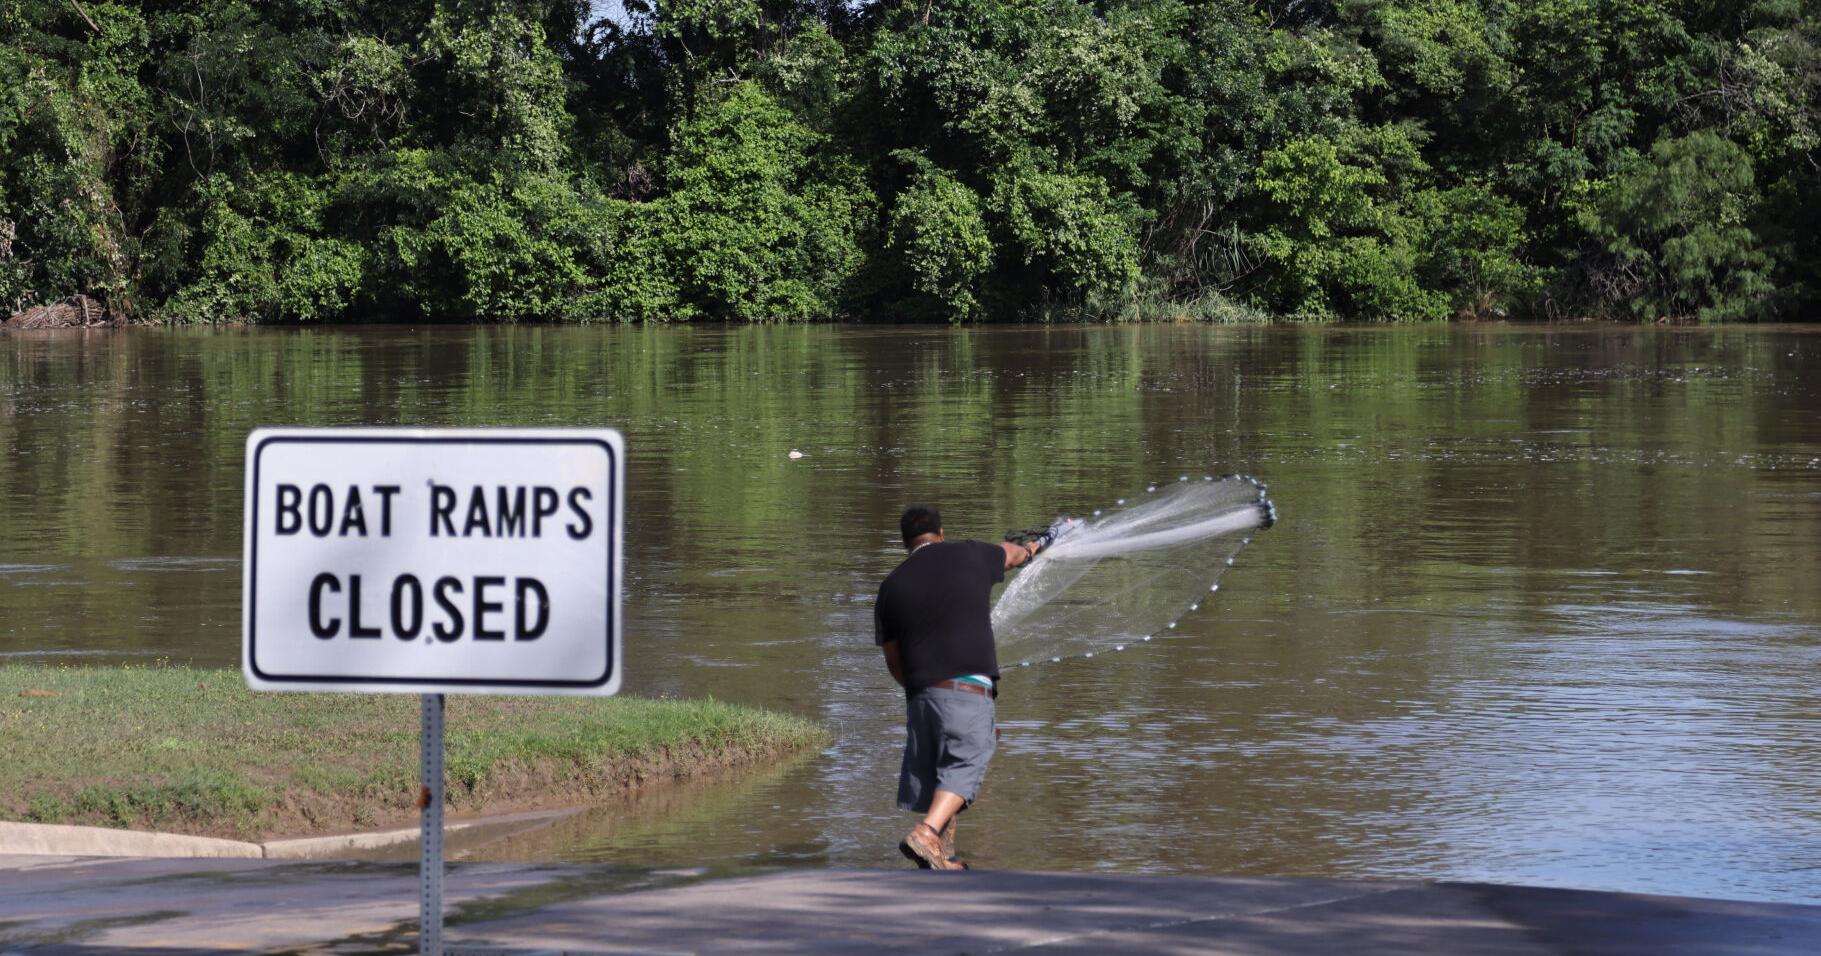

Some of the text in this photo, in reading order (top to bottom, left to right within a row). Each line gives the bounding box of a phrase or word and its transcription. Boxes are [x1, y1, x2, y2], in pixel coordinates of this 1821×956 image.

[275, 483, 594, 541] BOAT RAMPS
[308, 571, 551, 643] CLOSED
